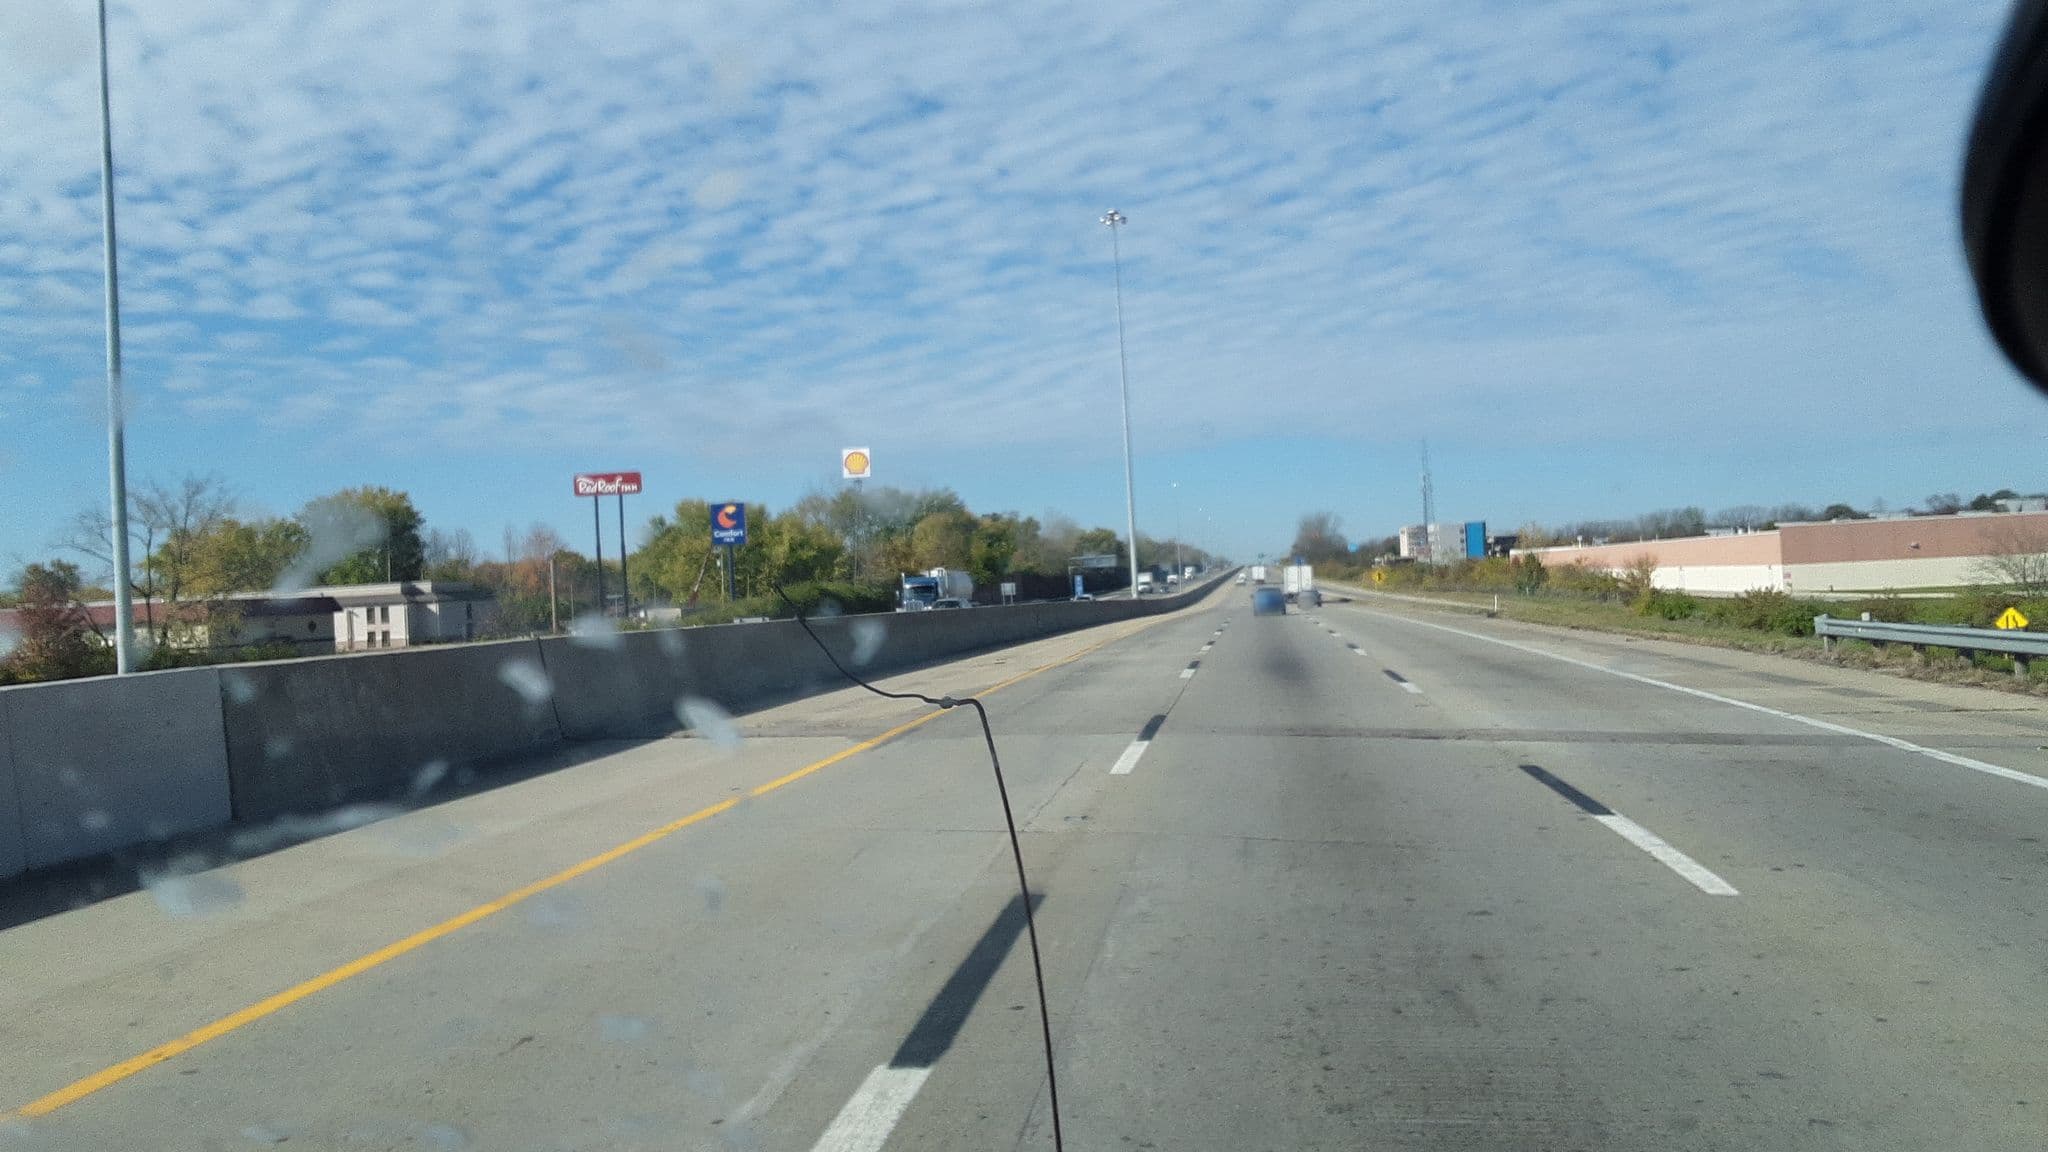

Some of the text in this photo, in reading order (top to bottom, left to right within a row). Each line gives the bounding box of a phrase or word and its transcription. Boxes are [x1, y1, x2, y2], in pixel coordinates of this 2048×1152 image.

[578, 480, 598, 494] Red
[598, 476, 622, 494] Roof
[714, 529, 744, 538] Comfort
